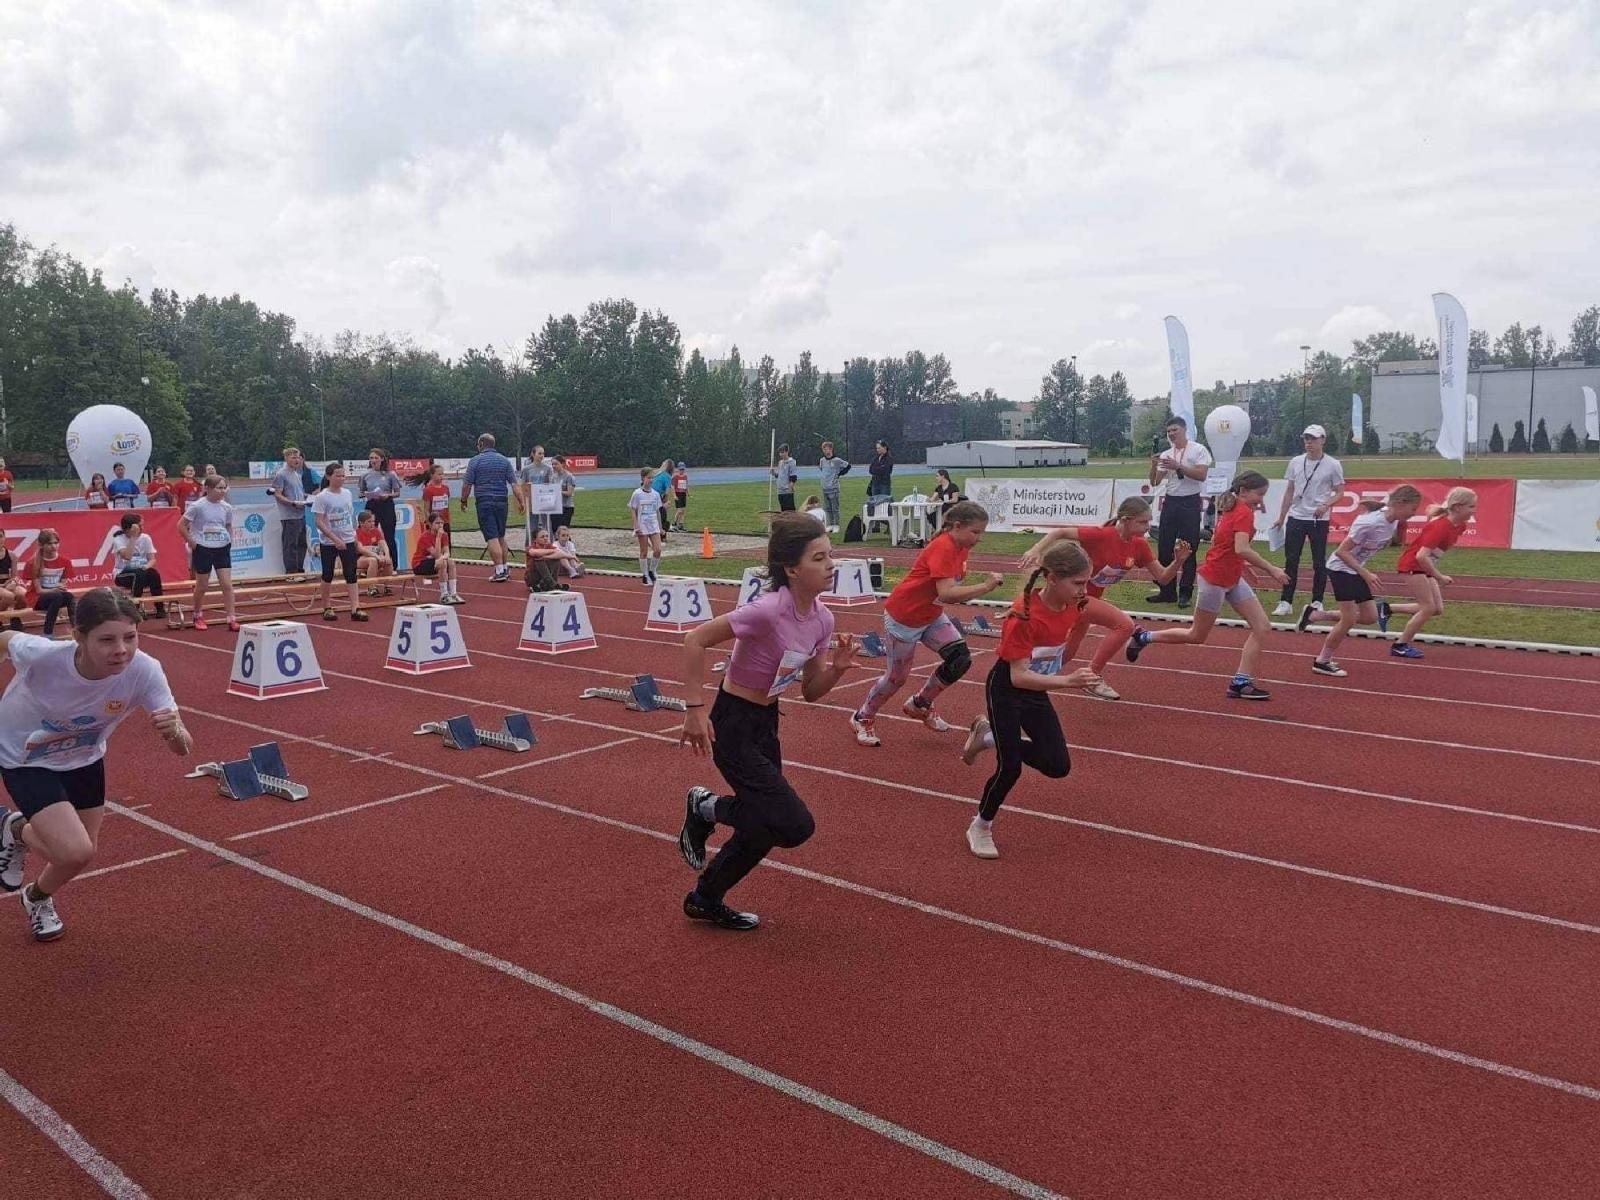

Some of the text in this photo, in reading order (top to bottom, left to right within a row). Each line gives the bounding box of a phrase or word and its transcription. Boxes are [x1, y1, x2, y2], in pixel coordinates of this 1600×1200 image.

[394, 461, 424, 470] PZLA
[1013, 488, 1086, 501] Ministerstwo
[1012, 503, 1057, 517] Edukacji
[1064, 504, 1098, 516] Nauki
[746, 578, 762, 603] 2
[853, 568, 864, 594] 1
[658, 589, 702, 618] 3 3
[530, 604, 581, 638] 4 4
[397, 620, 451, 656] 5 5
[241, 639, 302, 679] 6 6
